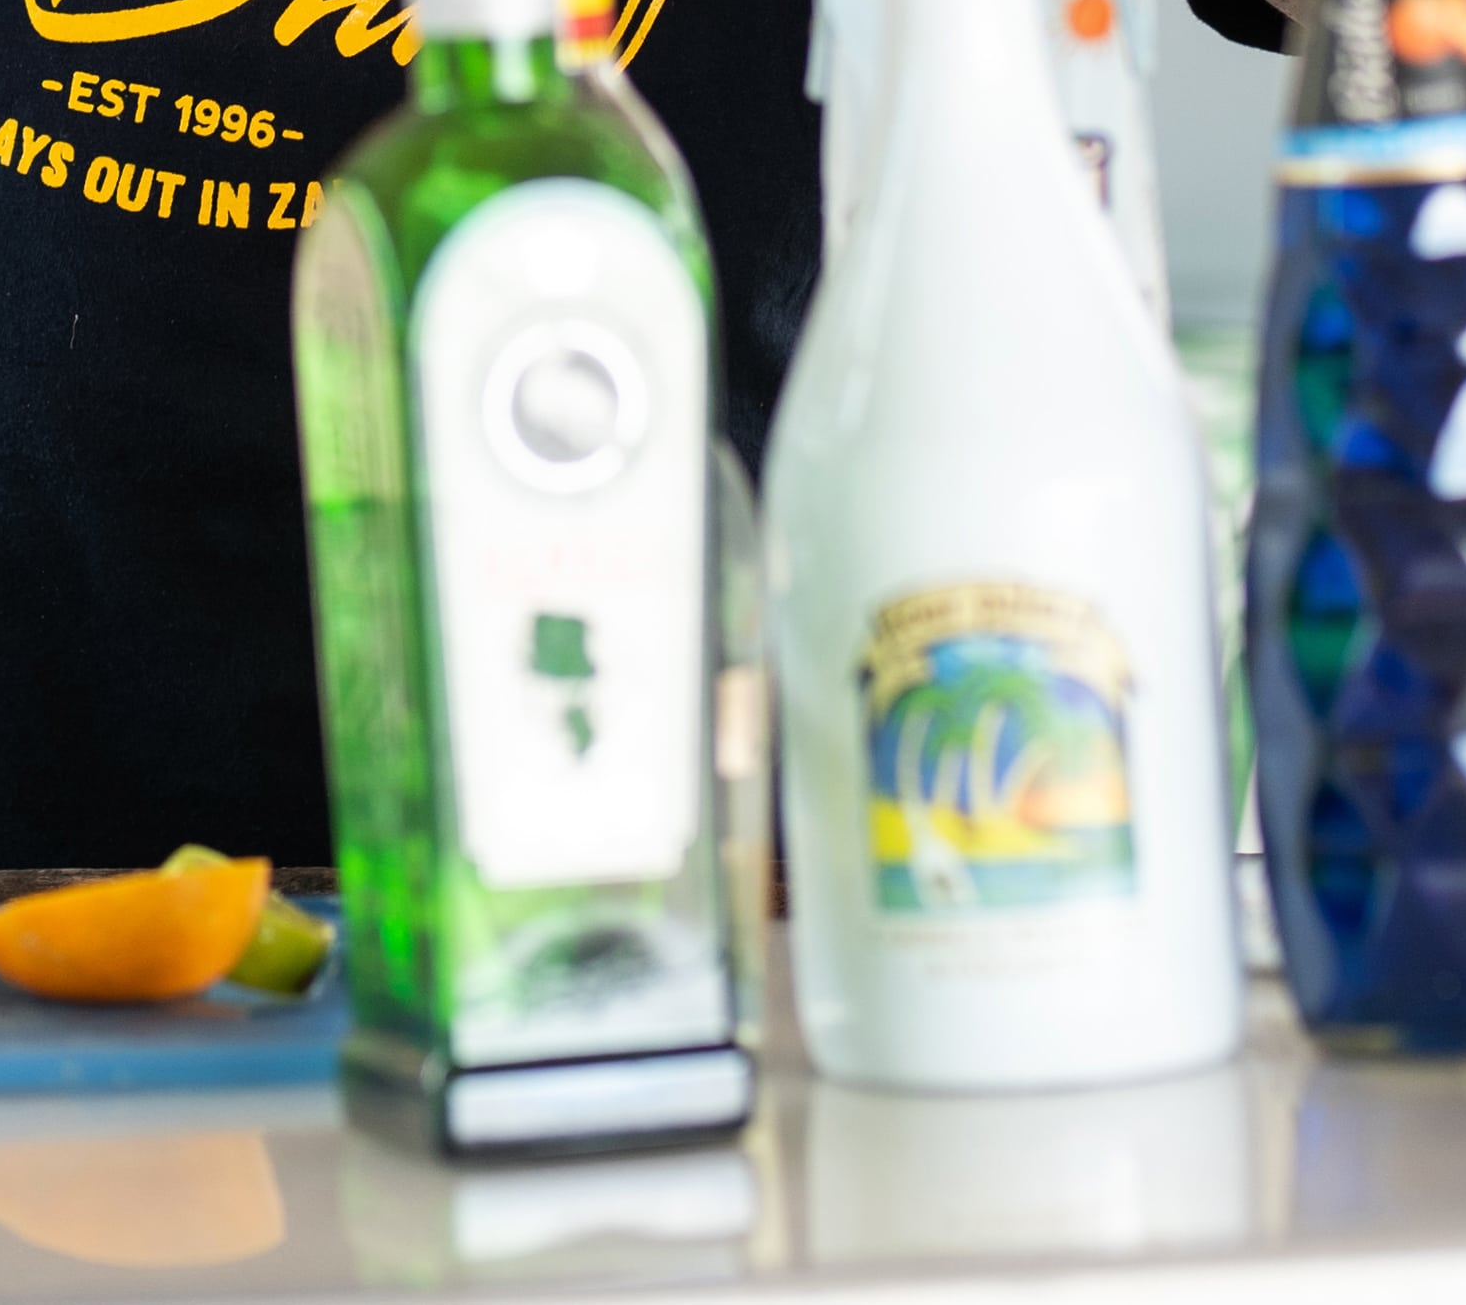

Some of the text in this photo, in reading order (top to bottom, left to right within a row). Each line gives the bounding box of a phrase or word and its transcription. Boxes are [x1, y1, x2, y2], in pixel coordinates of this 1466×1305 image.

[83, 156, 187, 219] OUT
[197, 179, 251, 229] IN
[267, 180, 330, 230] ZA
